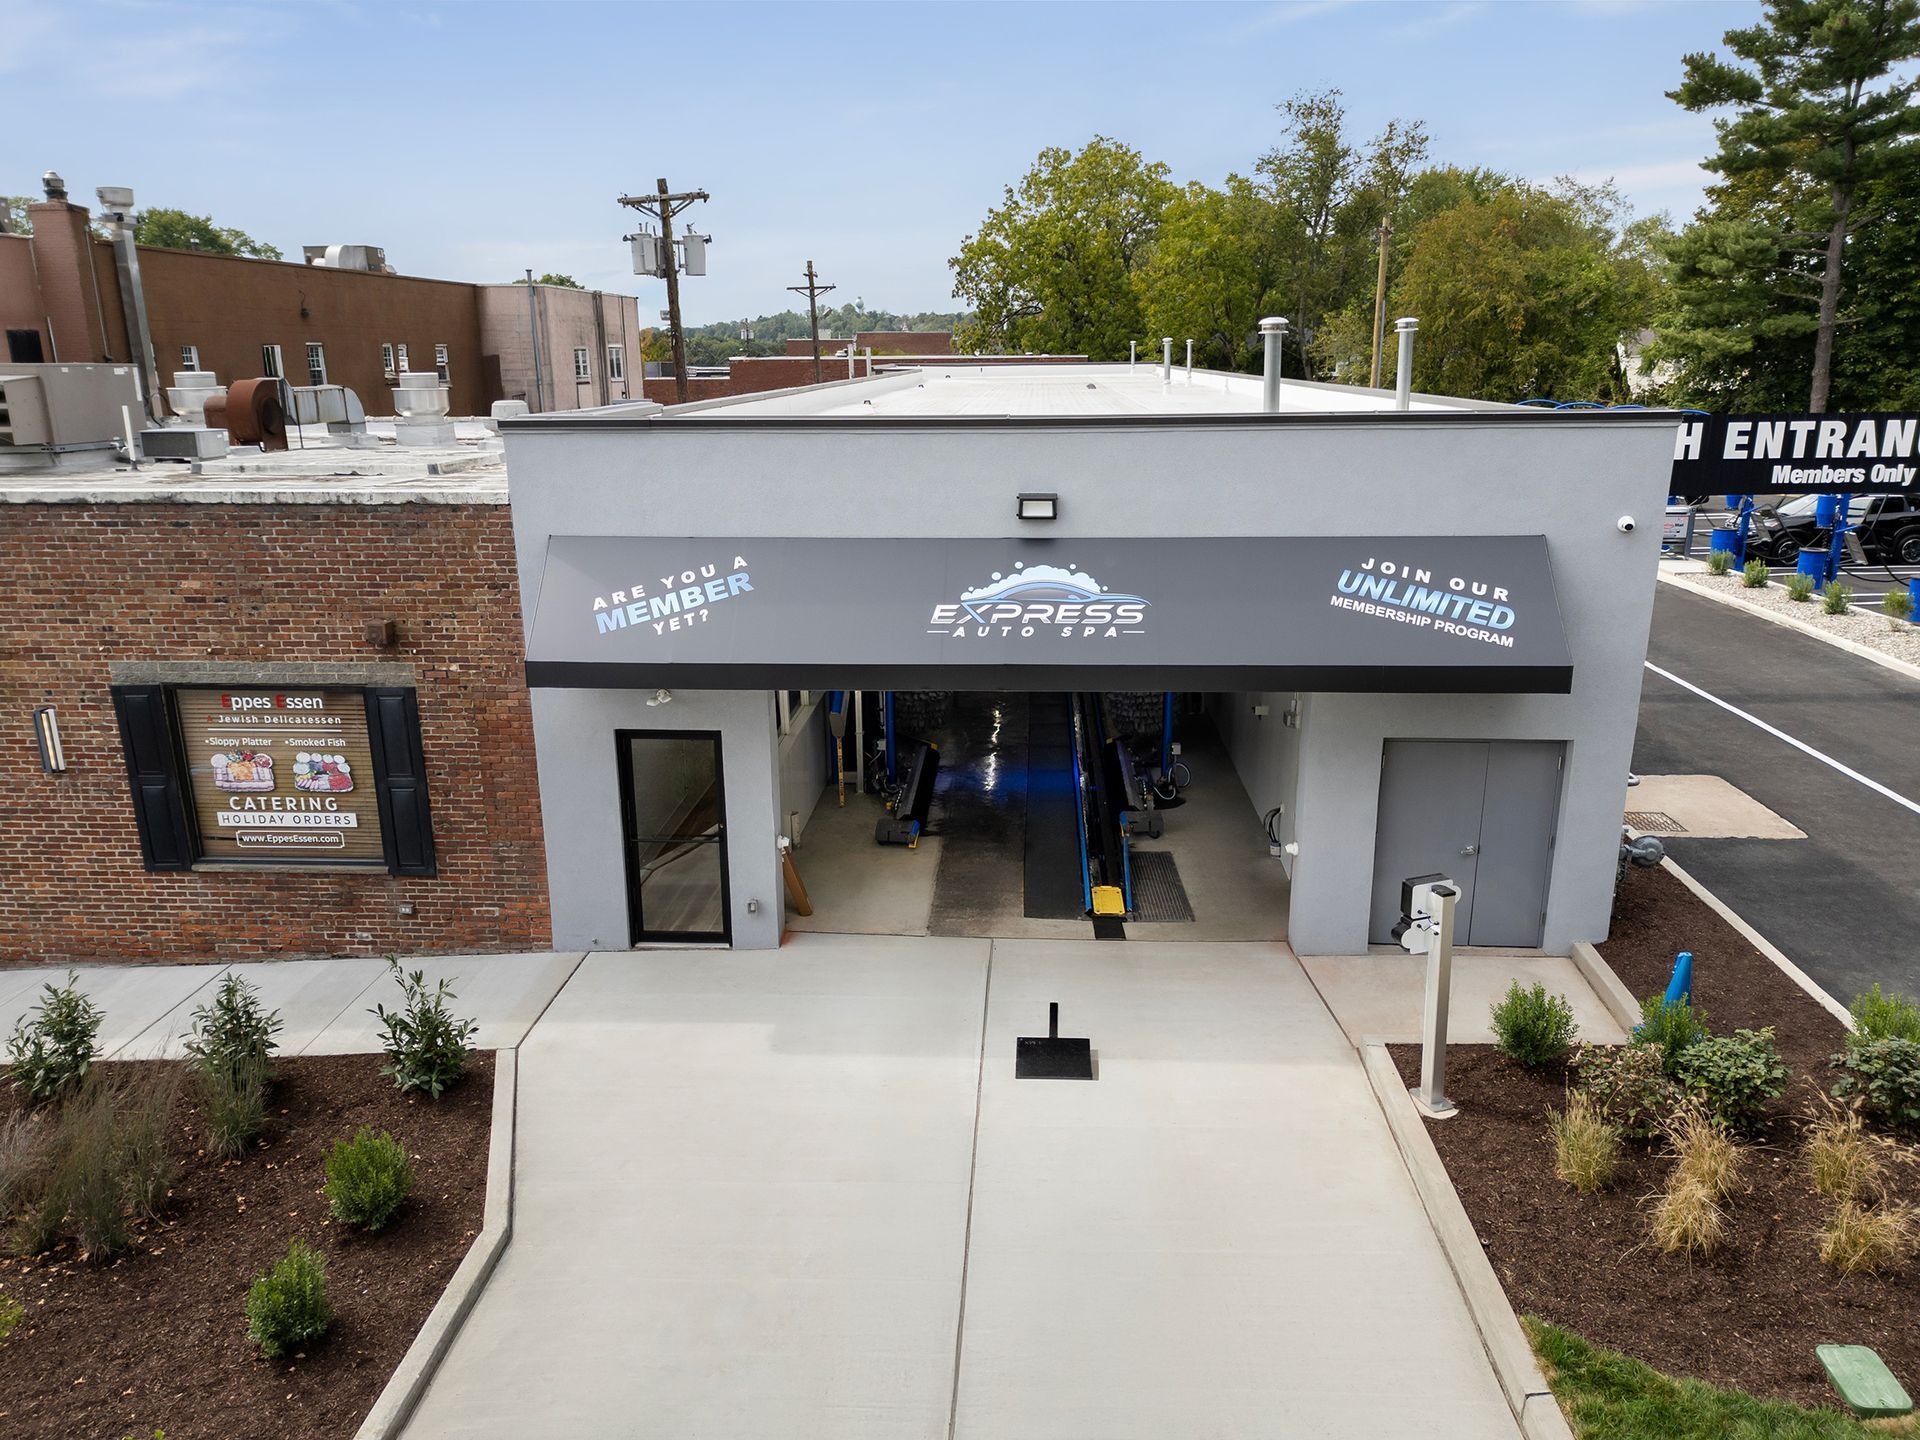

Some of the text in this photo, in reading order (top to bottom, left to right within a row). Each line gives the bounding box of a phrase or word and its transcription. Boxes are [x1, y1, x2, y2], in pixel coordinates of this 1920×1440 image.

[1723, 419, 1920, 460] ENTRAN
[1771, 463, 1917, 486] Members Only
[593, 556, 748, 611] ARE YOU A
[1361, 557, 1509, 602] JOIN OUR
[595, 572, 755, 634] MEMBER
[1337, 569, 1516, 630] UNLIMITED
[652, 609, 709, 635] YET?
[930, 602, 1146, 624] EXPRESS
[1330, 595, 1515, 648] MEMBERSHIP PROGRAM
[952, 626, 1118, 638] AUTO SPA
[221, 694, 323, 710] Eppes Essen
[217, 715, 258, 724] Jewish
[264, 715, 342, 725] Delicatessen
[242, 737, 272, 746] Platter
[327, 738, 346, 747] Fish
[229, 796, 338, 811] CATERING
[221, 814, 351, 825] HOLIDAY ORDERS
[241, 834, 339, 844] www.EppesEssen.com
